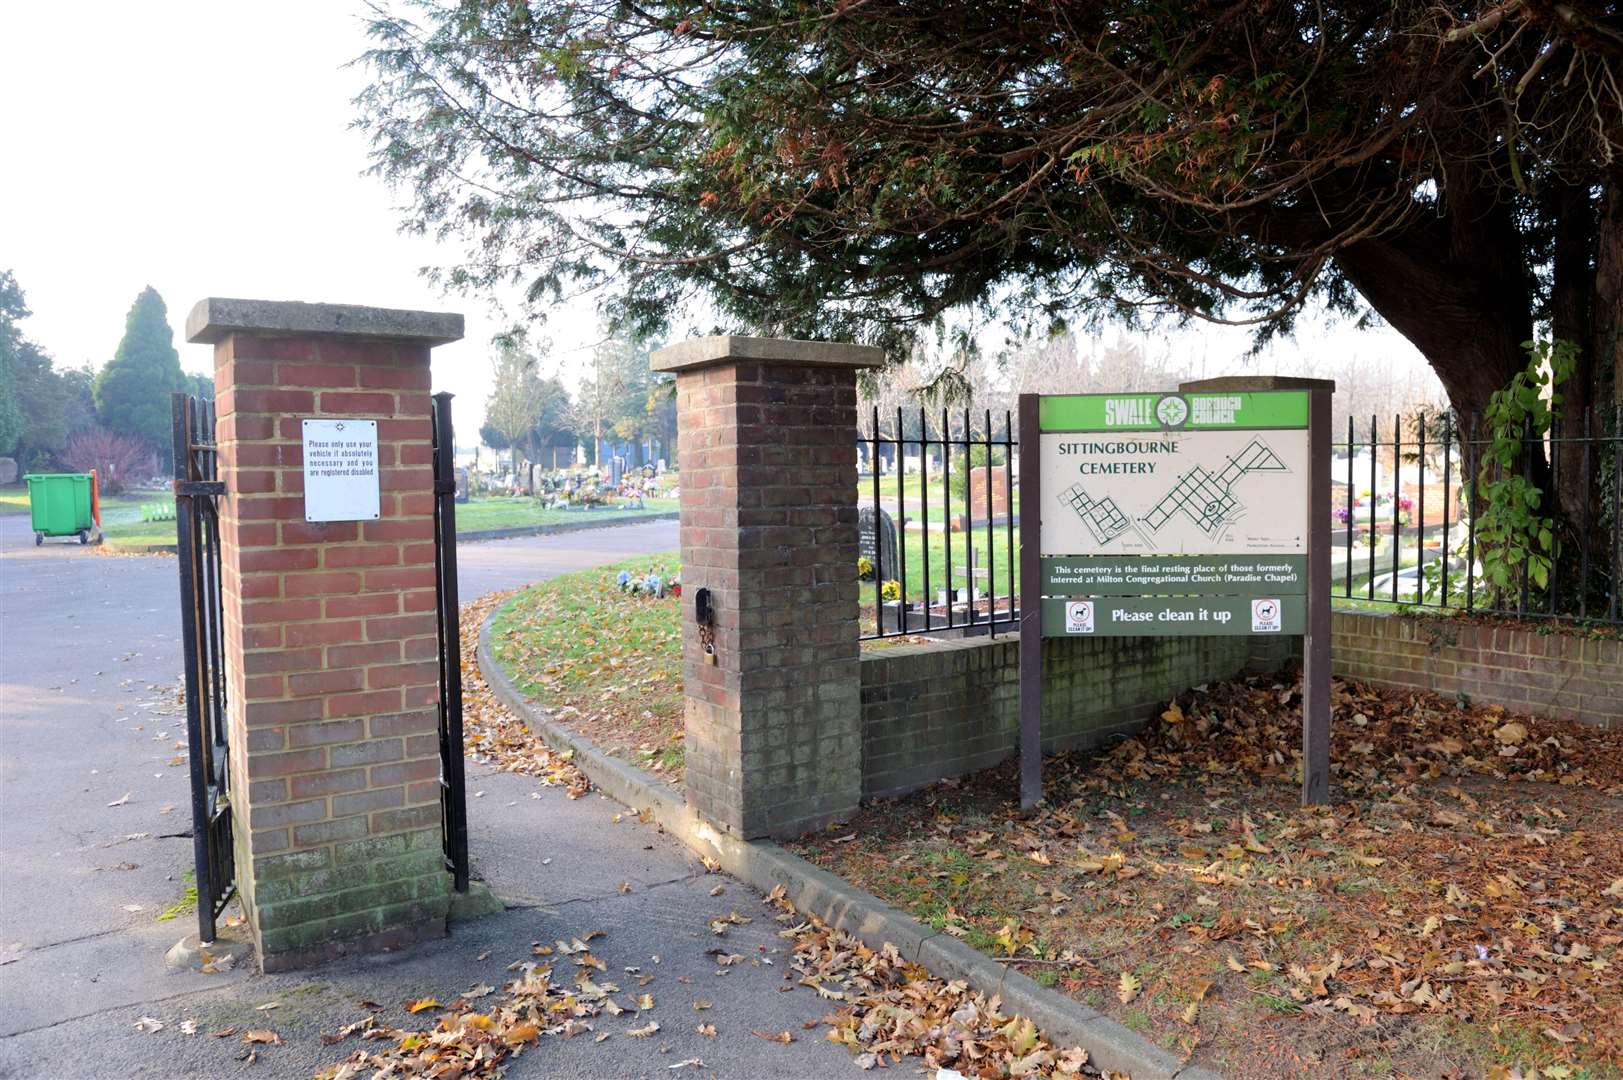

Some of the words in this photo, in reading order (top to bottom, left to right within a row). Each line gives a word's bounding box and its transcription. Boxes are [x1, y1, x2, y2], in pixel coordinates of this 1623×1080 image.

[1105, 398, 1152, 425] SWALE
[308, 440, 329, 448] Please
[331, 440, 343, 448] only
[359, 441, 371, 449] your
[1058, 441, 1179, 455] SITTINGBOURNE
[341, 450, 373, 458] absolutely
[309, 460, 343, 468] necessary
[1079, 462, 1156, 475] CEMETERY
[320, 469, 350, 477] registered
[1055, 566, 1071, 574] This
[1073, 566, 1113, 575] cemetery
[1115, 565, 1122, 573] is
[1124, 565, 1138, 573] the
[1141, 564, 1159, 573] final
[1162, 564, 1191, 574] resting
[1193, 564, 1216, 573] place
[1218, 563, 1228, 572] of
[1230, 563, 1254, 572] those
[1256, 563, 1293, 574] formerly
[1050, 575, 1083, 583] interred
[1096, 575, 1123, 583] Milton
[1126, 574, 1188, 584] Congregational
[1191, 574, 1221, 582] Church
[1224, 573, 1261, 583] (Paradise
[1264, 573, 1298, 583] Chapel)
[1112, 609, 1154, 621] Please
[1158, 608, 1194, 621] clean
[1199, 607, 1209, 621] it
[1213, 611, 1232, 624] up
